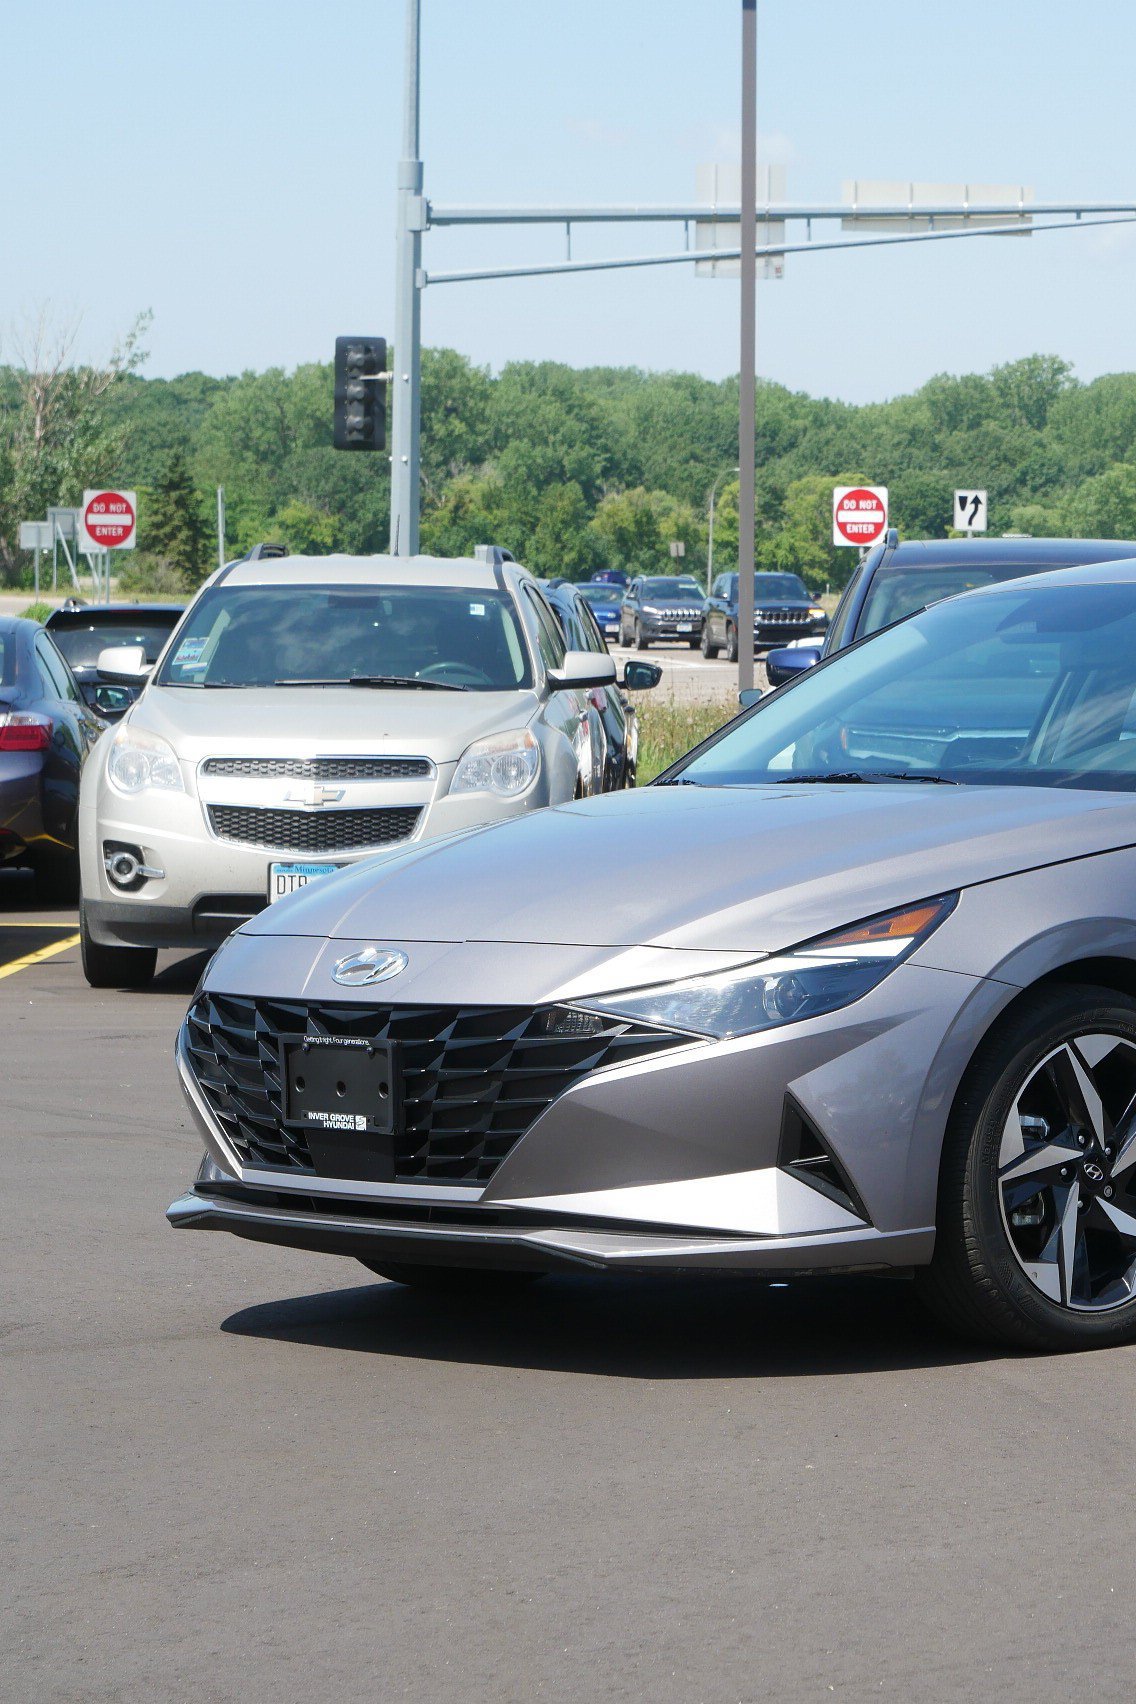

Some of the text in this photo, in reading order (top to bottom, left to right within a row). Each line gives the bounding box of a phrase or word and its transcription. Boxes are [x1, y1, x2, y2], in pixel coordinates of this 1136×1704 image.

[93, 503, 126, 513] DO NOT
[843, 499, 877, 510] DO NOT
[96, 527, 124, 536] ENTER
[846, 524, 875, 534] ENTER
[294, 865, 335, 874] Minnesota
[308, 1112, 355, 1122] INVER GROVE
[323, 1121, 355, 1130] HYUNDAI
